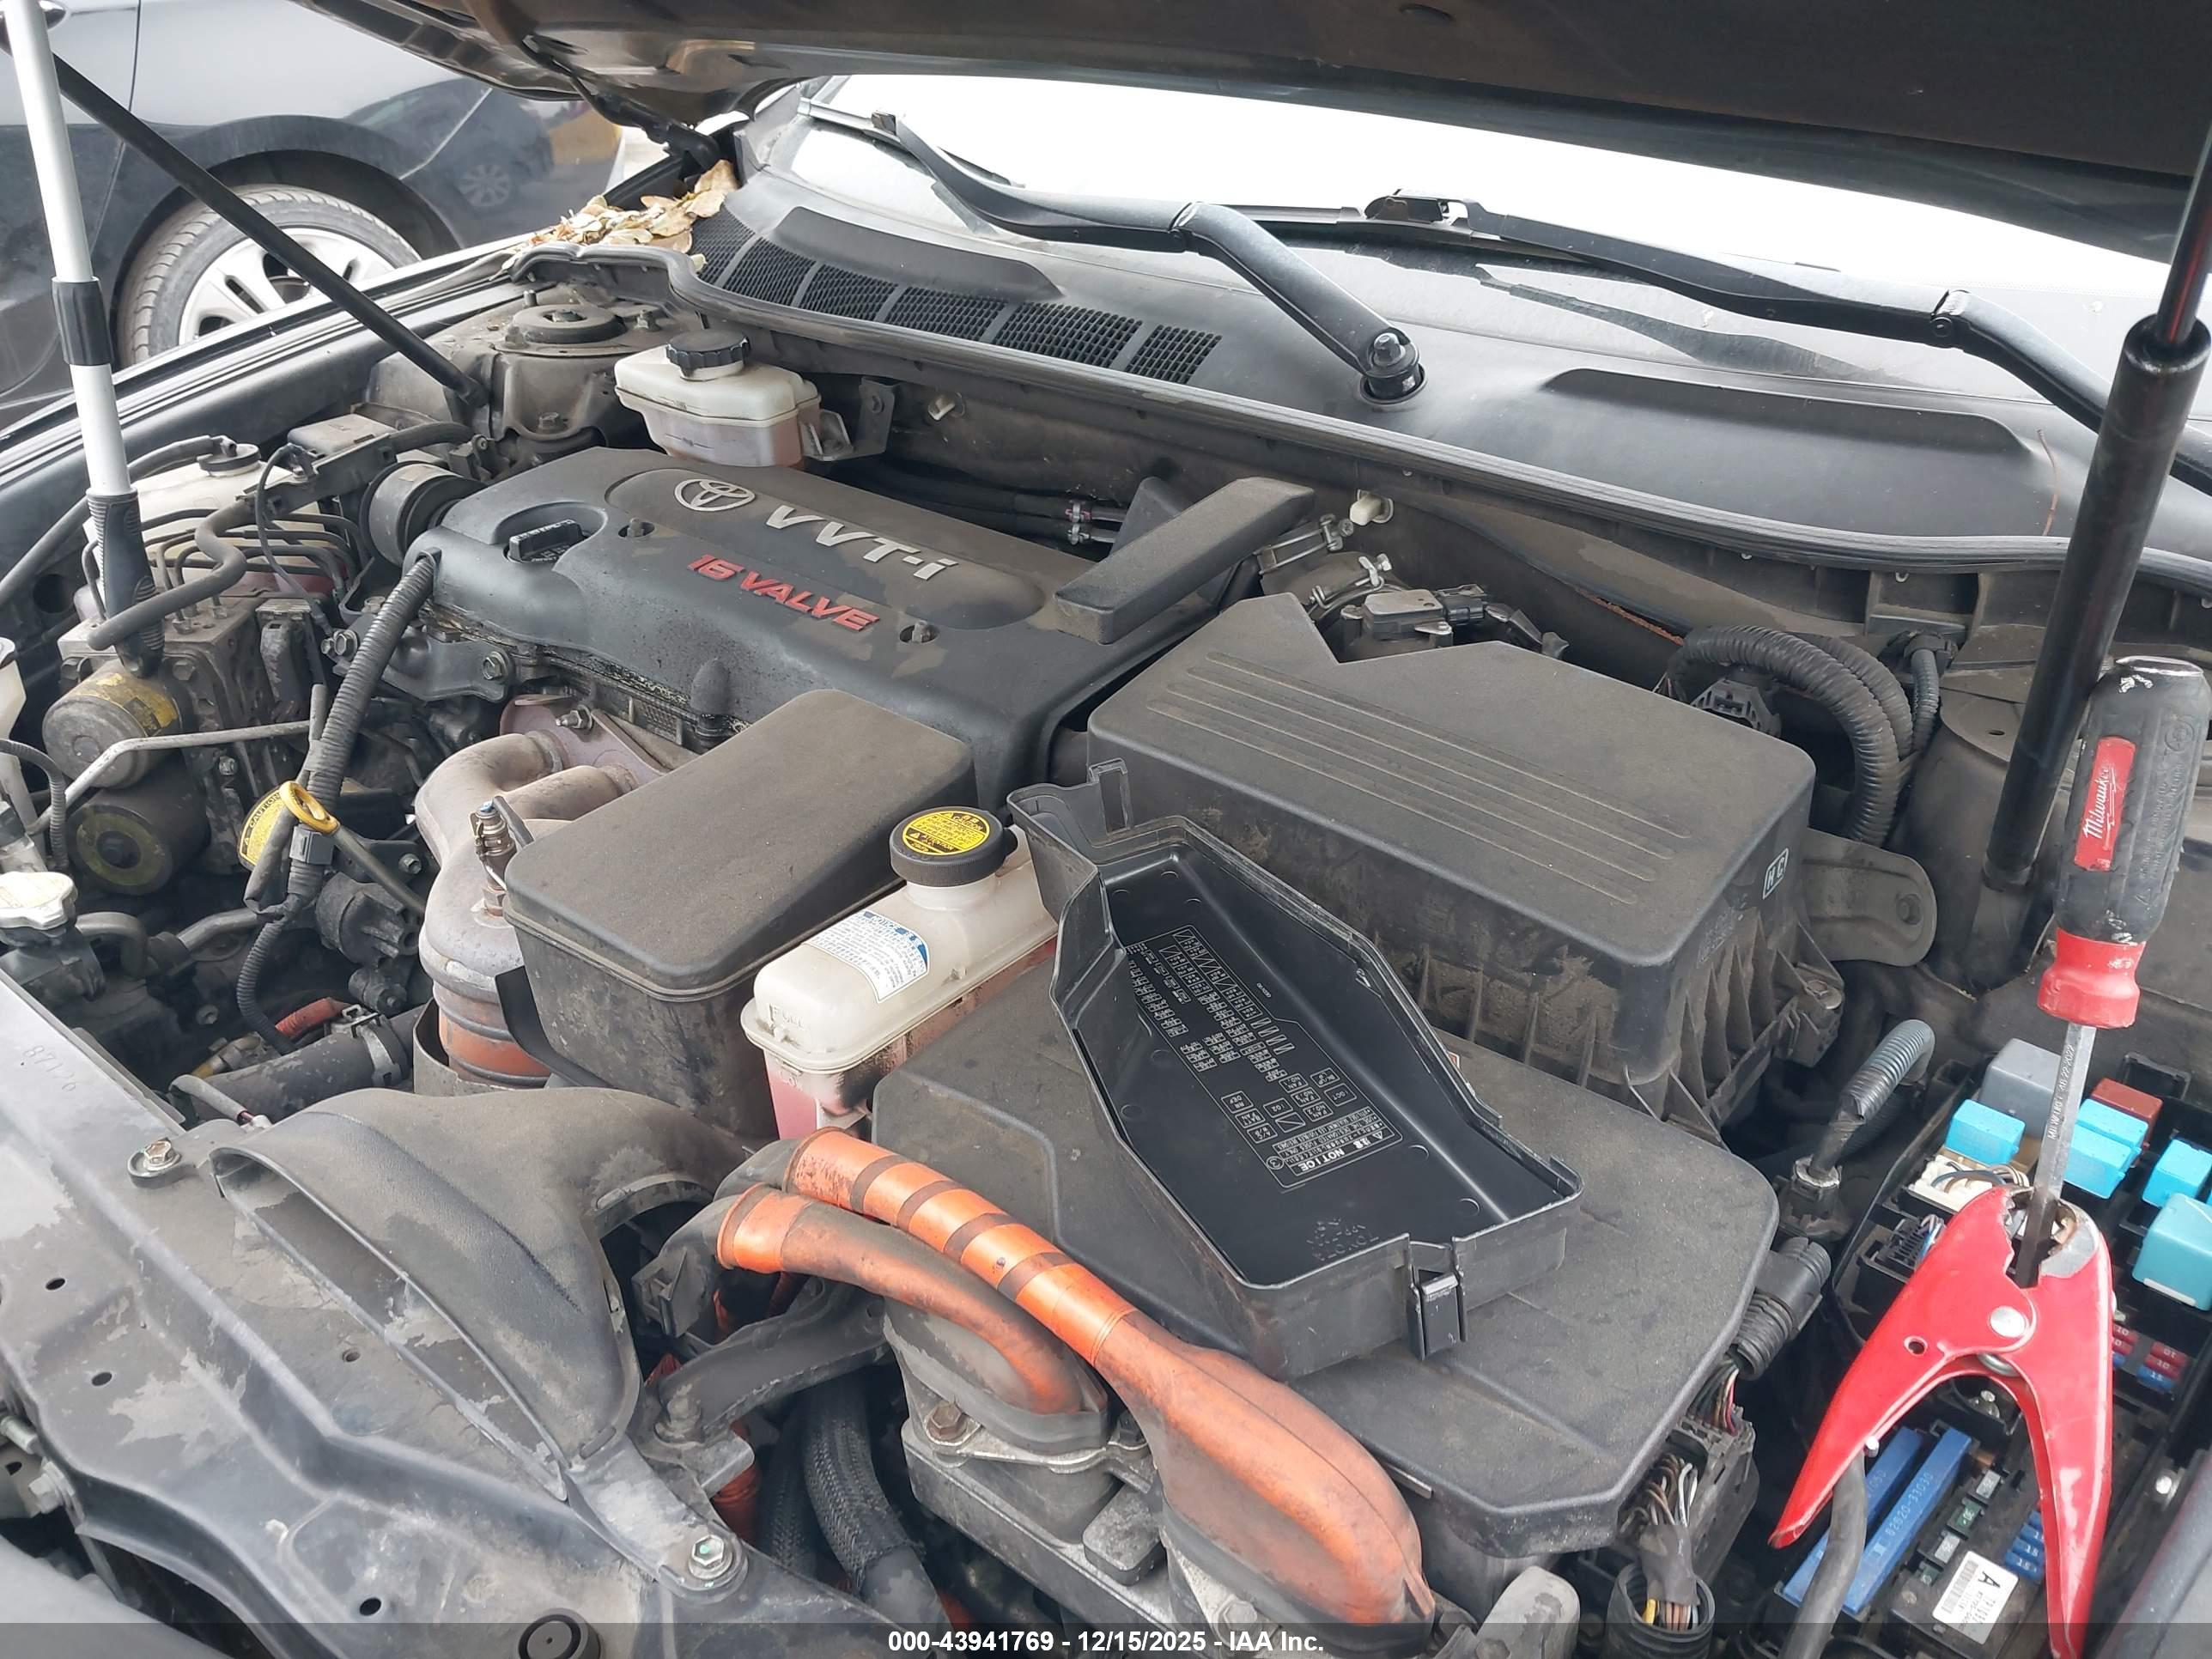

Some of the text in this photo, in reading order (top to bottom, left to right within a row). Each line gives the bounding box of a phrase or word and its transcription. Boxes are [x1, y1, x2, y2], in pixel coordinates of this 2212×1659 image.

[687, 554, 880, 632] 16 VALVE
[2082, 766, 2110, 838] Milwaukee
[1300, 1095, 1315, 1103] FAN
[1298, 1149, 1345, 1170] NOTICE
[2117, 1326, 2130, 1336] 10
[2156, 1359, 2170, 1370] 10
[1978, 1571, 2001, 1589] A
